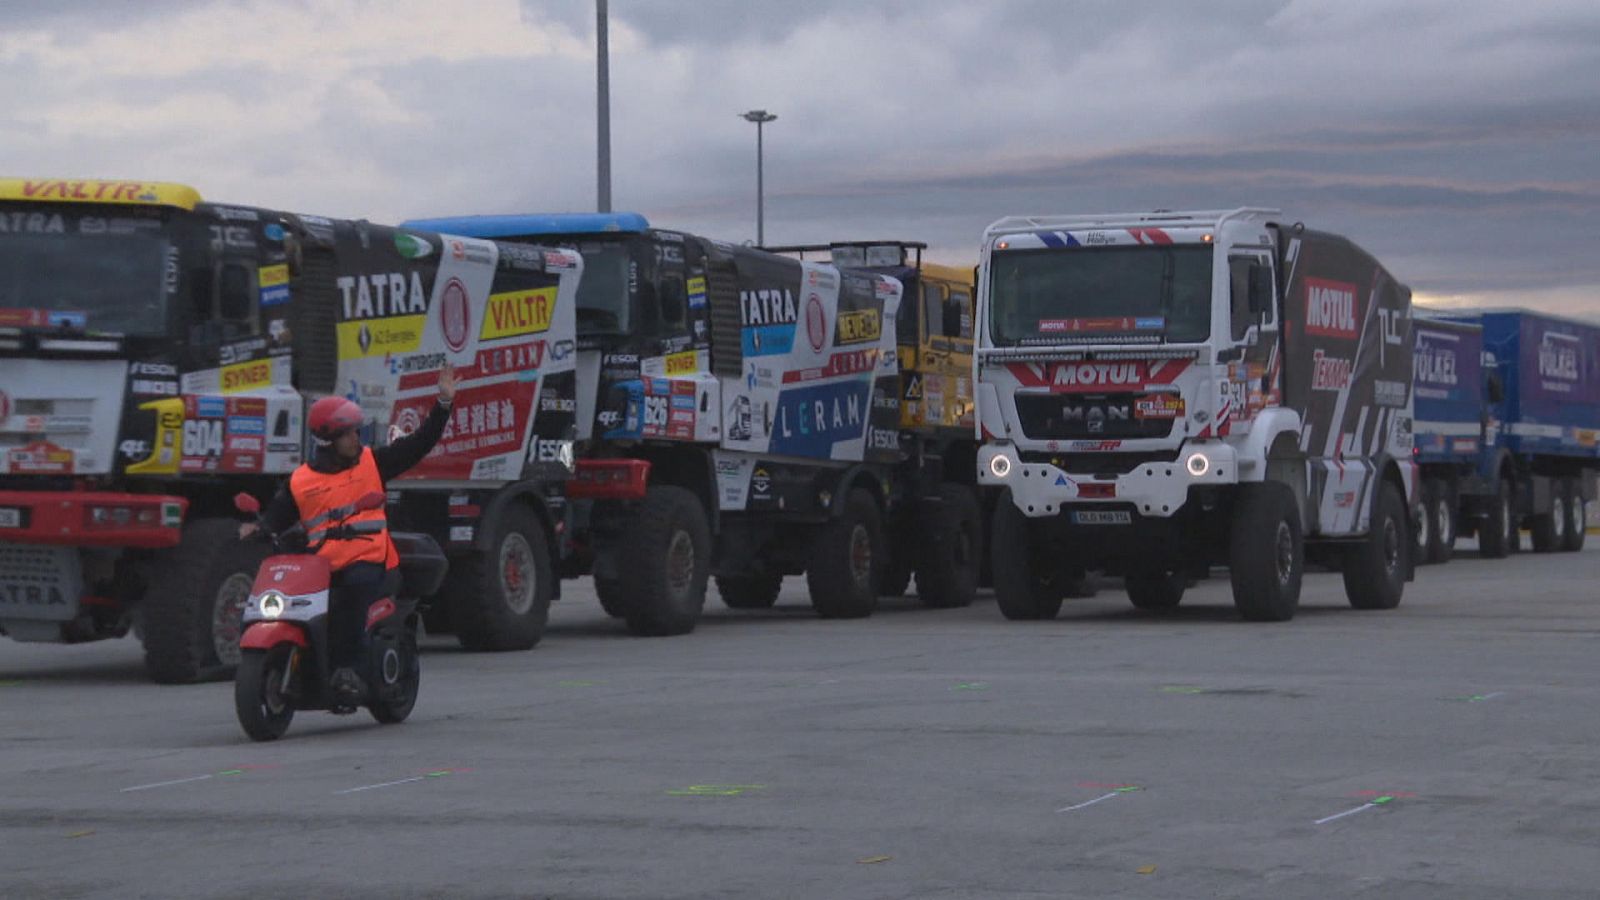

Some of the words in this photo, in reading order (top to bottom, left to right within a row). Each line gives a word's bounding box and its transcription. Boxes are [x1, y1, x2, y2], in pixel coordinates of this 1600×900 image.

[22, 181, 143, 200] VALTR
[337, 271, 427, 319] TATRA
[740, 289, 798, 325] TATRA
[1307, 285, 1356, 330] MOTUL
[491, 295, 548, 331] VALTR
[480, 345, 538, 375] LERAM
[1054, 363, 1141, 386] MOTUL
[223, 364, 269, 390] SYNER
[781, 394, 860, 438] LERAM
[1062, 406, 1130, 421] MAN
[183, 420, 223, 456] 604
[0, 584, 66, 606] TRA
